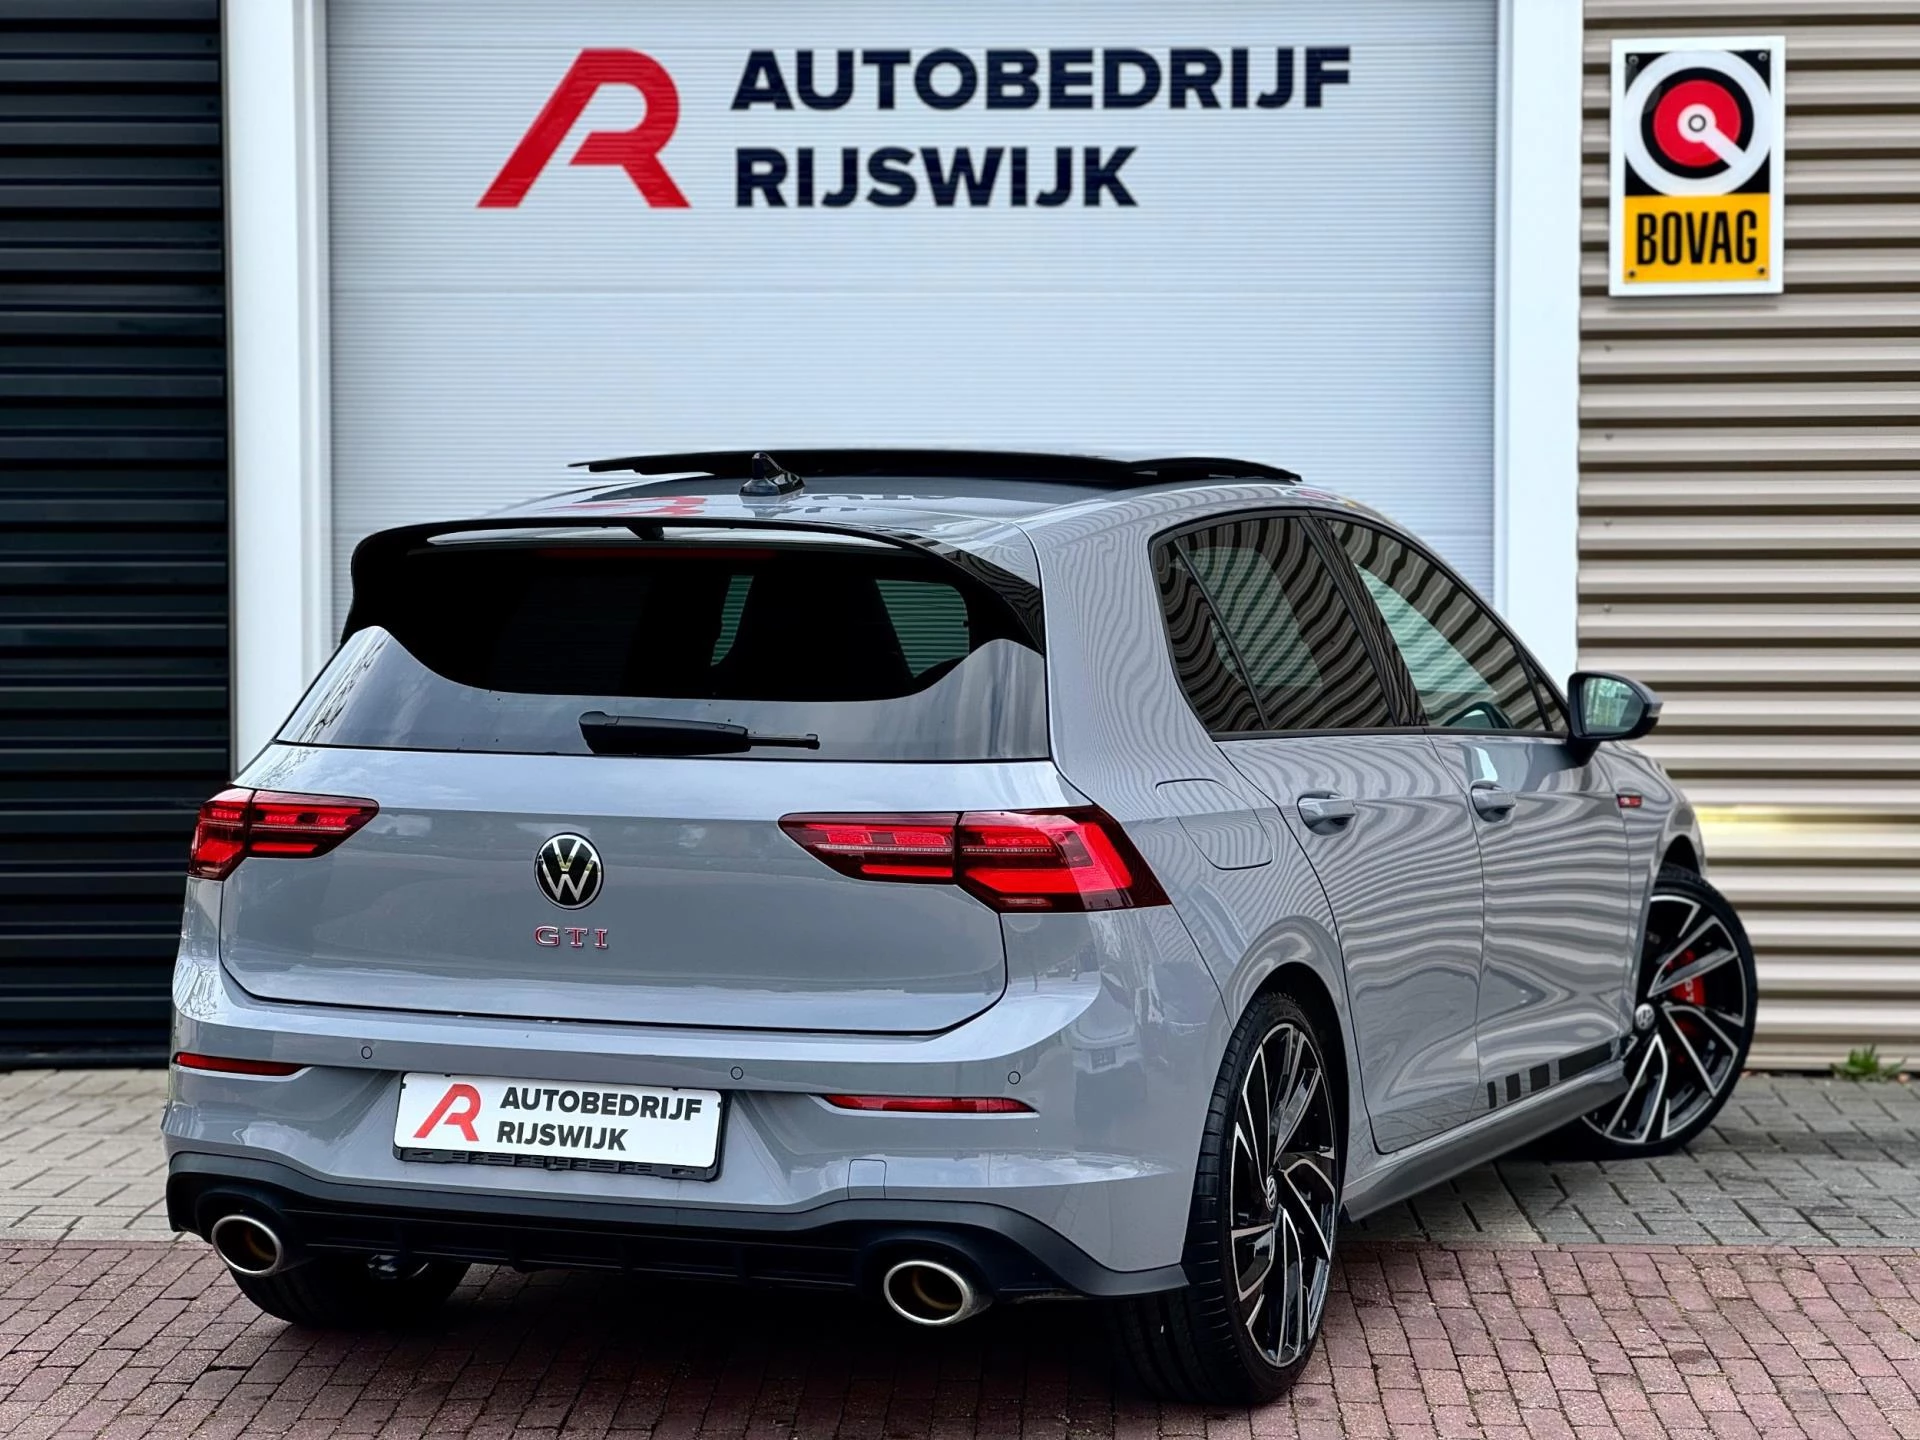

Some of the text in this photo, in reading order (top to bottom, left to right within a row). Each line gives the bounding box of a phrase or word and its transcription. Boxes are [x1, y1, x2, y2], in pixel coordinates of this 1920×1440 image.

[731, 47, 1351, 111] AUTOBEDRIJF
[736, 146, 1138, 208] RIJSWIJK
[1636, 210, 1757, 266] BOVAG
[535, 925, 609, 949] GTI
[500, 1086, 702, 1121] AUTOBEDRIJF
[497, 1120, 629, 1151] RIJSWIJK
